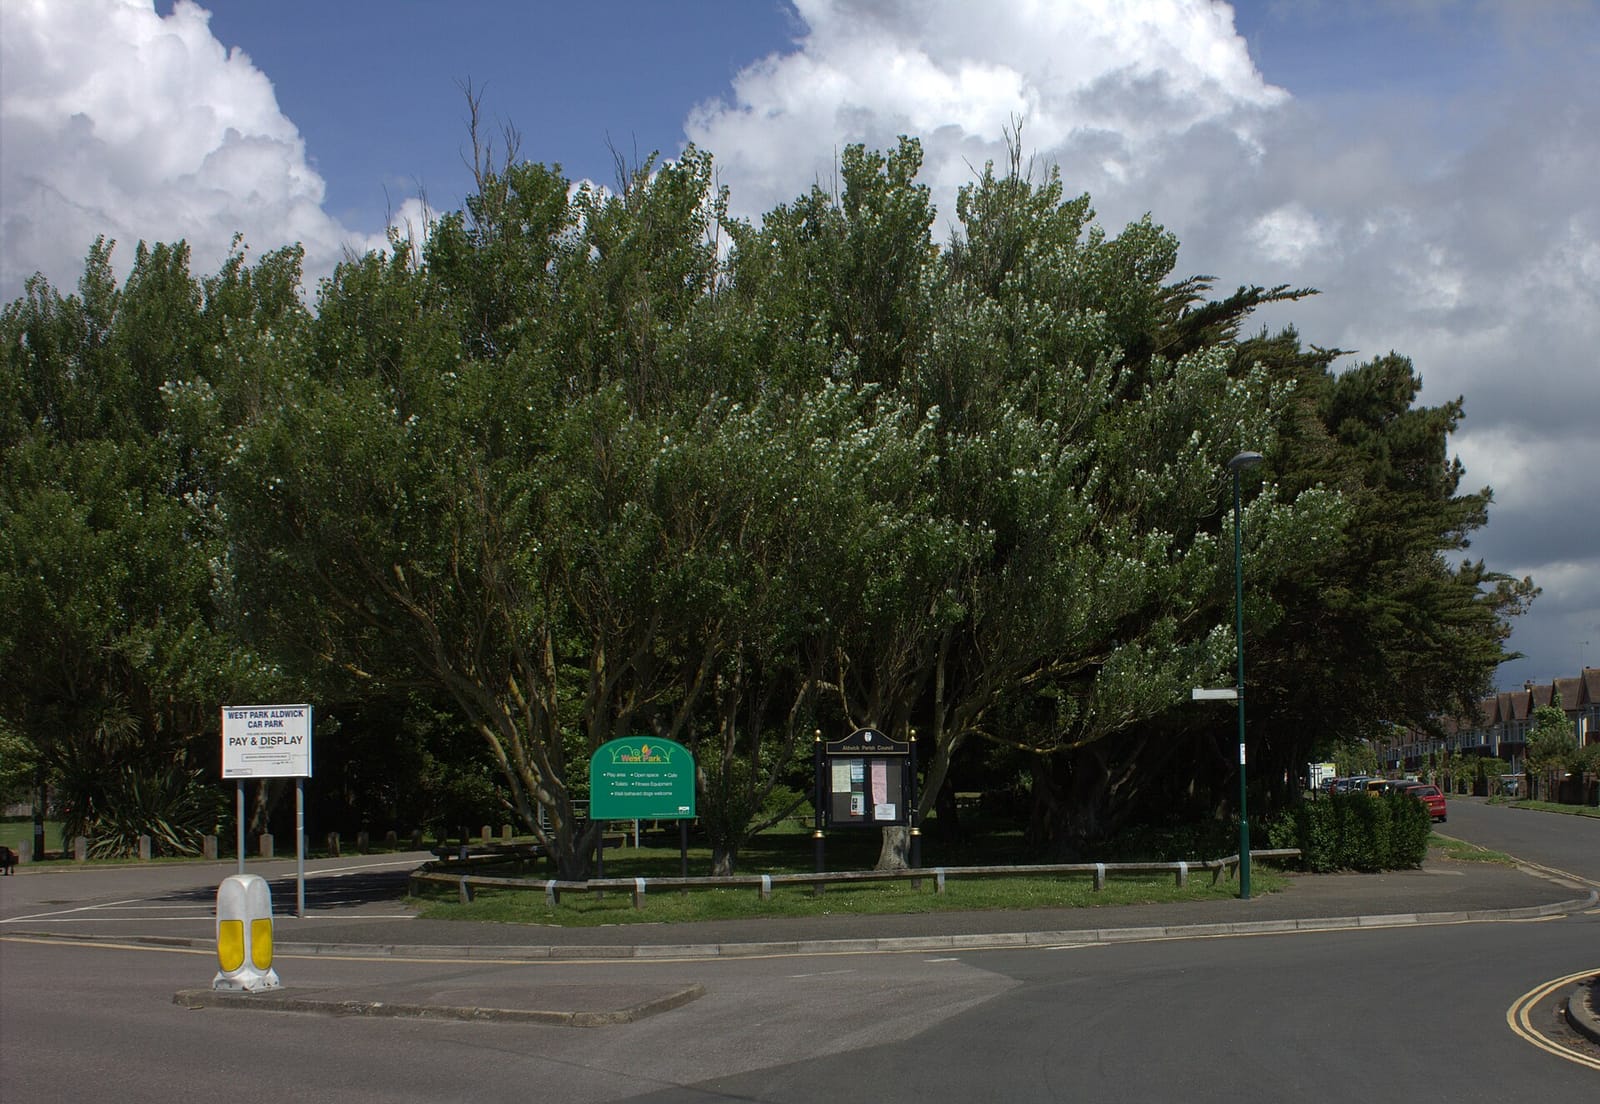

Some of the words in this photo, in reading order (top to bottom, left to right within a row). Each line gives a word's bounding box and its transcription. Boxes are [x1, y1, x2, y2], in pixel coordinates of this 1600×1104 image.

[270, 710, 304, 718] ALDWICK
[229, 737, 248, 746] PAY
[250, 737, 257, 745] &
[260, 736, 303, 745] DISPLAY
